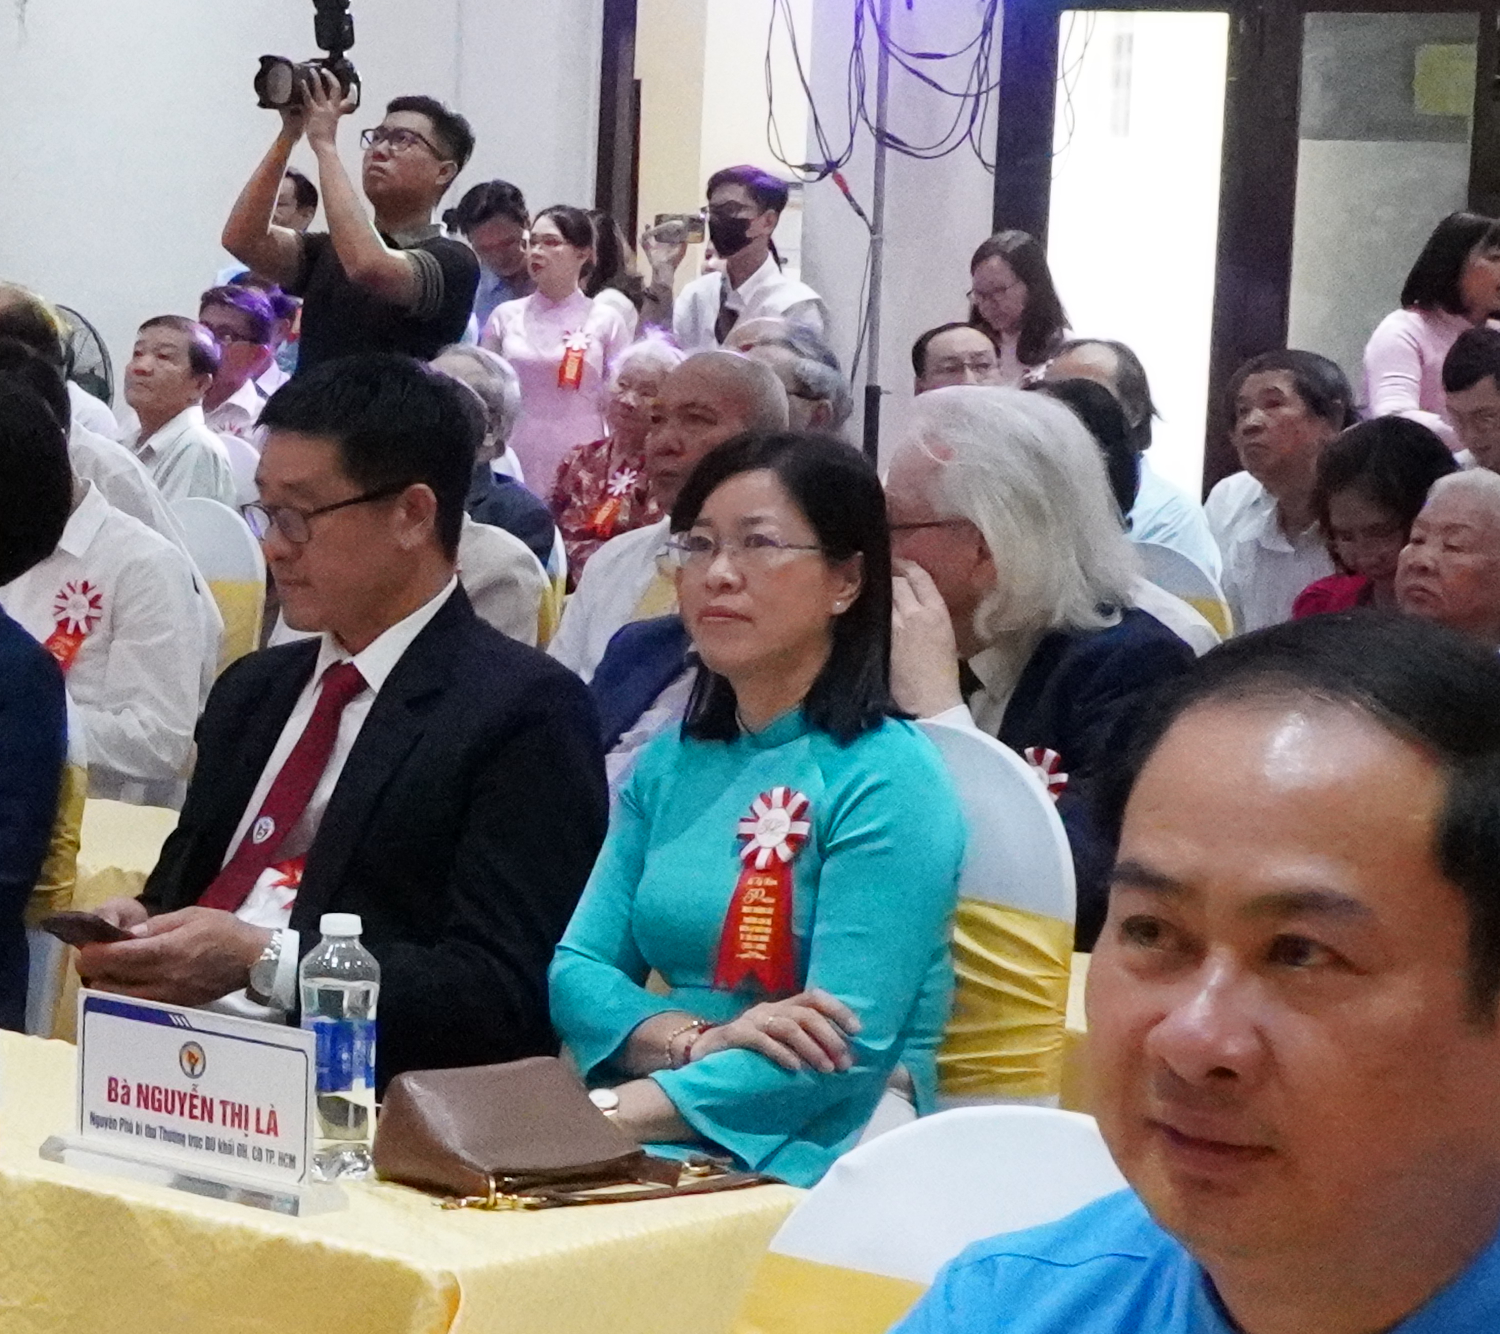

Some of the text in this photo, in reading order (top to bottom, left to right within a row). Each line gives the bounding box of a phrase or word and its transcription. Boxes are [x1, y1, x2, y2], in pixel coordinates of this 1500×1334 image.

[107, 1075, 279, 1138] Bà NGUYỄN THỊ LÀ
